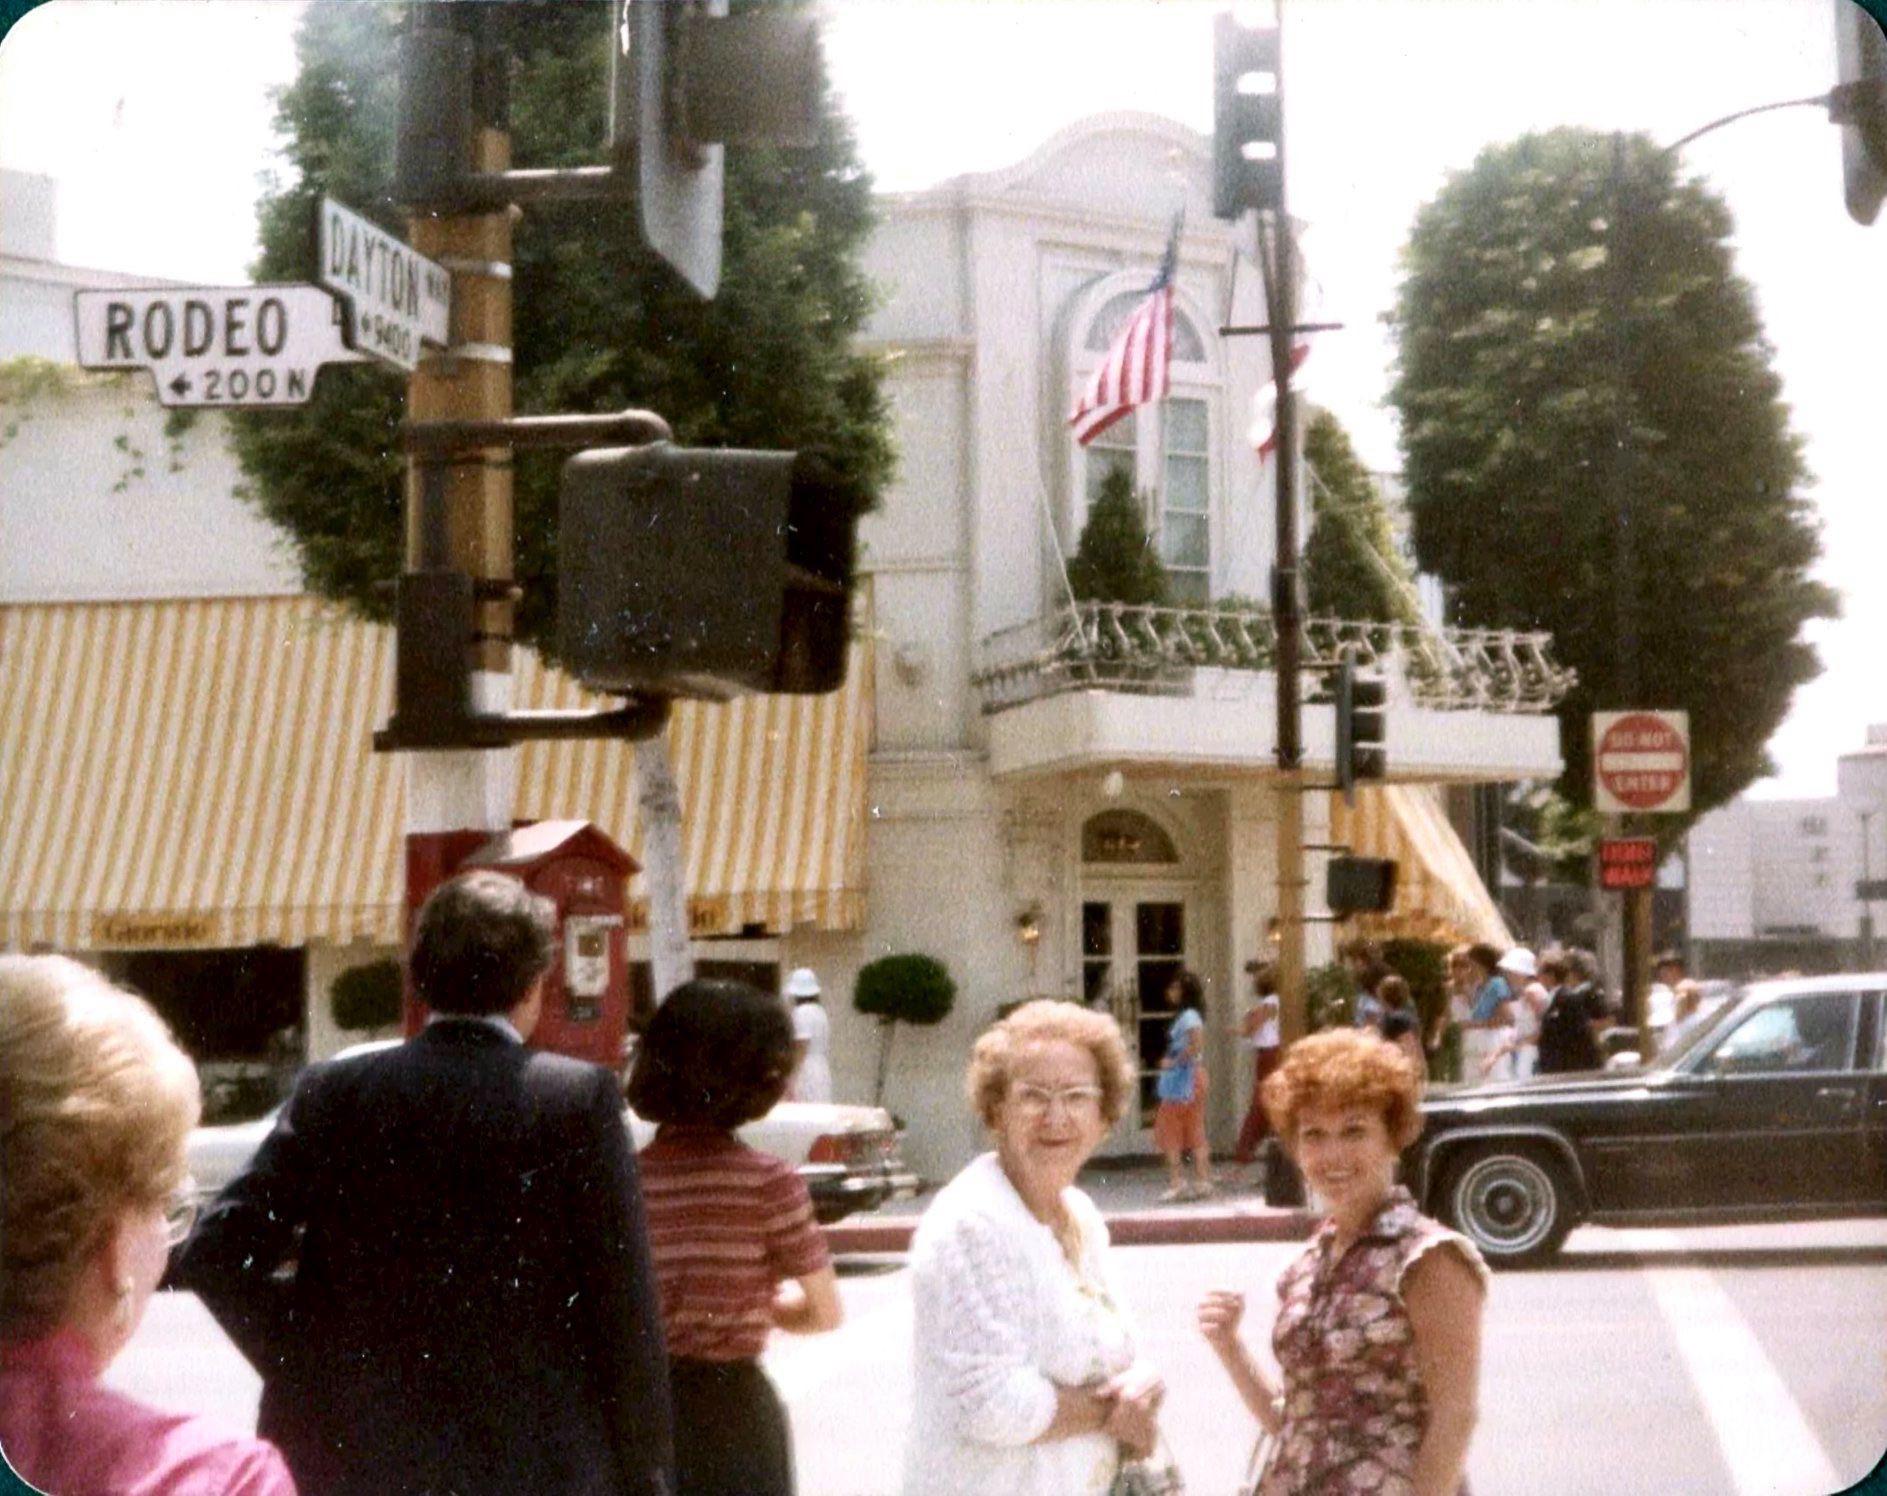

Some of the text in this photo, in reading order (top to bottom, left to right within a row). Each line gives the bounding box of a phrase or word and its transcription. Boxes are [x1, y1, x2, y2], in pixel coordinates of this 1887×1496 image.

[331, 212, 419, 318] DAYTON
[105, 297, 288, 360] RODEO
[374, 313, 411, 362] 9400
[1639, 730, 1672, 748] NOT
